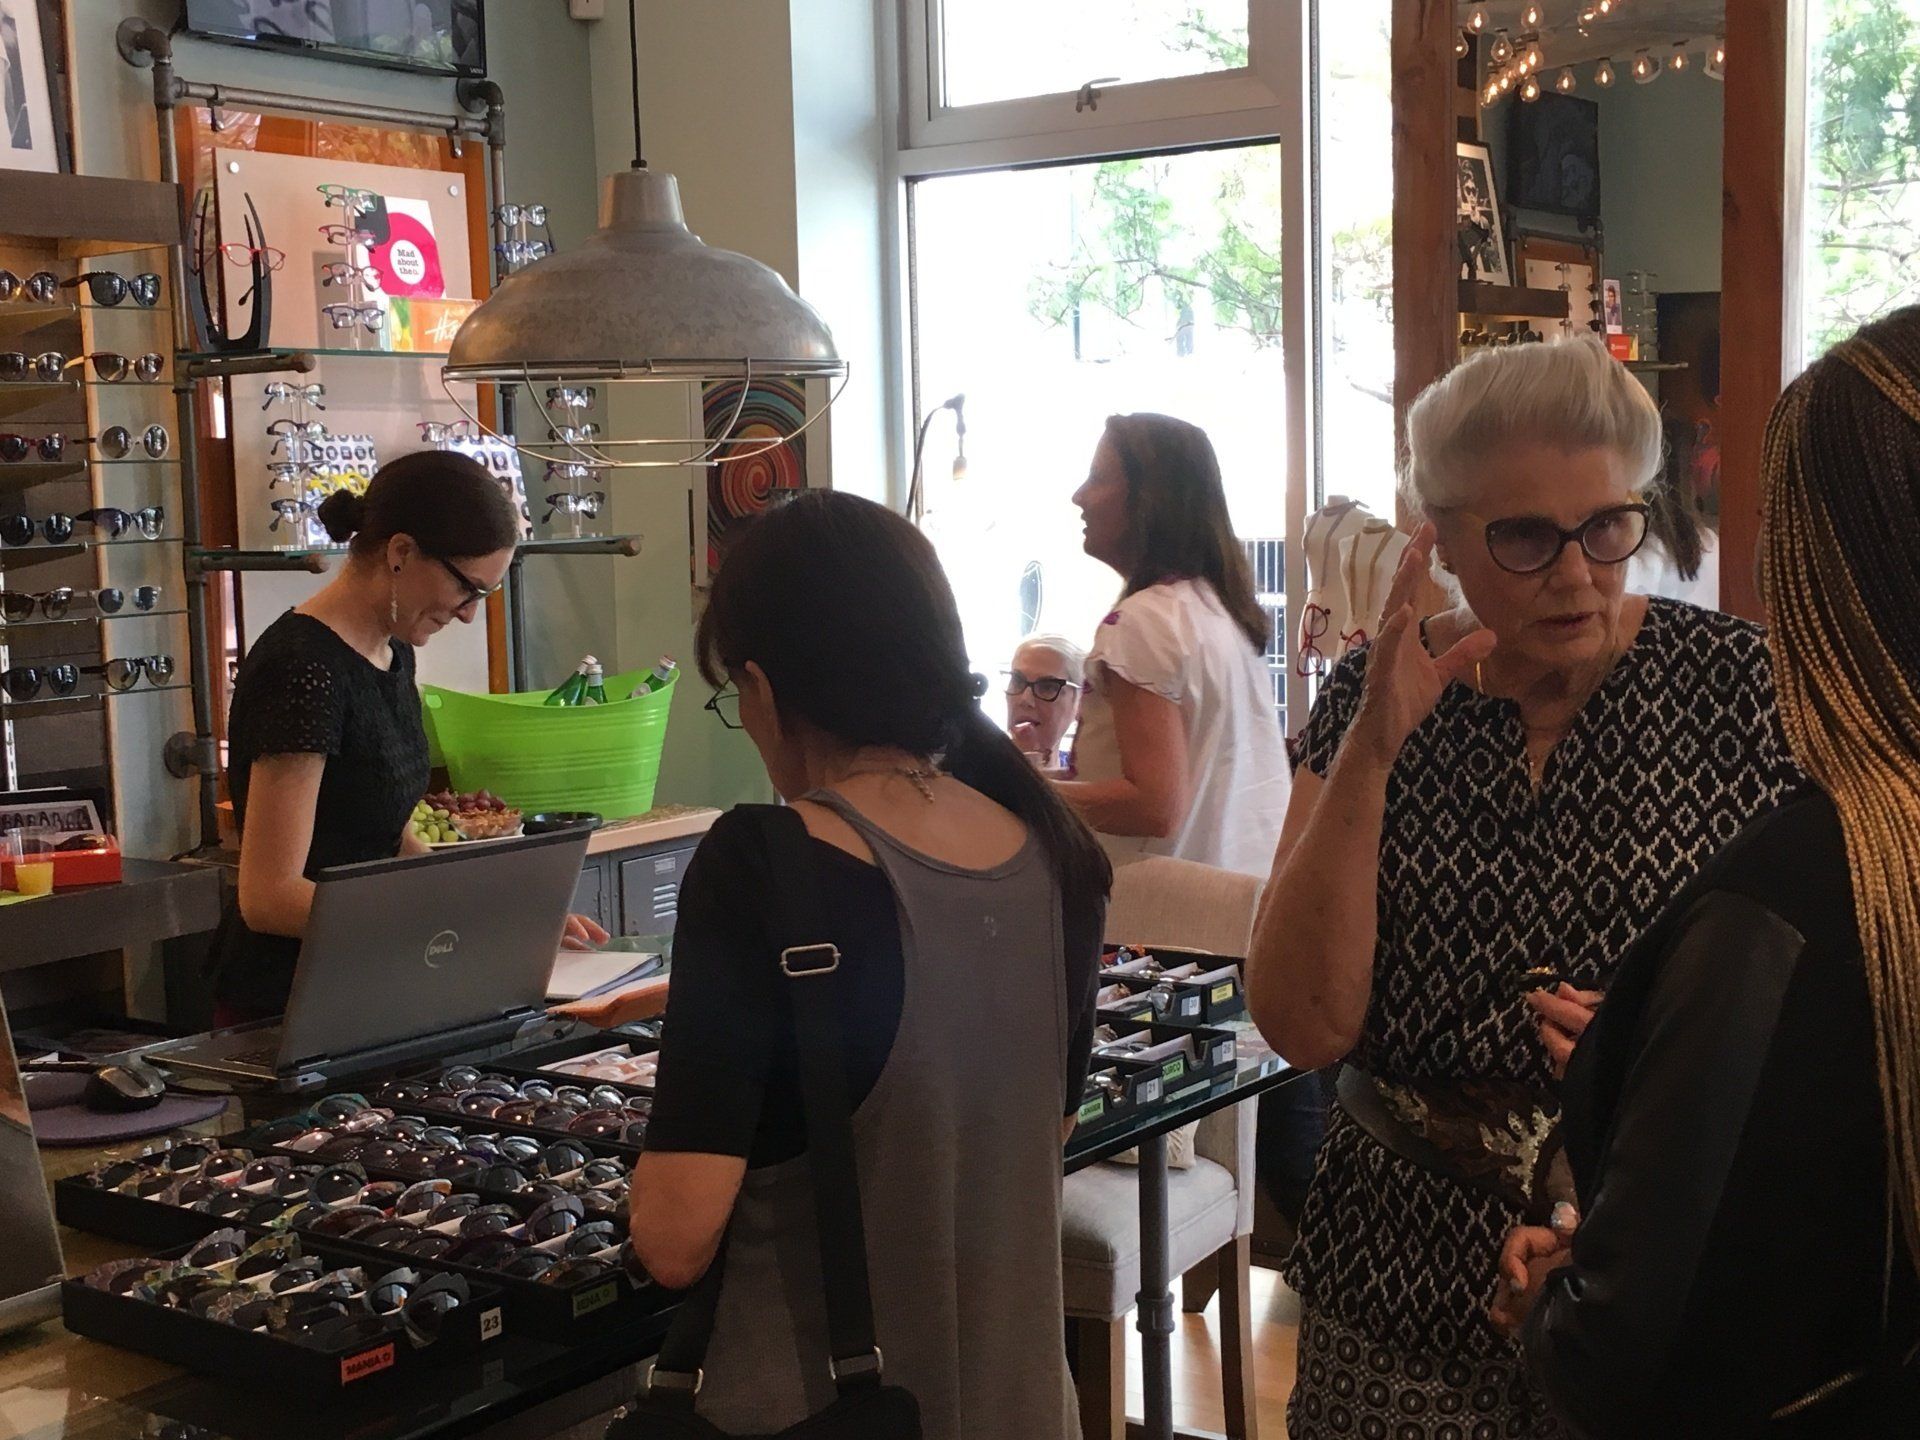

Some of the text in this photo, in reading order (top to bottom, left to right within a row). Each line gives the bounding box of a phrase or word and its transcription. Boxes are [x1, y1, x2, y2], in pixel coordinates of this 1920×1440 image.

[397, 249, 415, 257] Mad
[397, 258, 418, 266] about
[429, 942, 453, 956] DELL
[483, 1314, 500, 1333] 23
